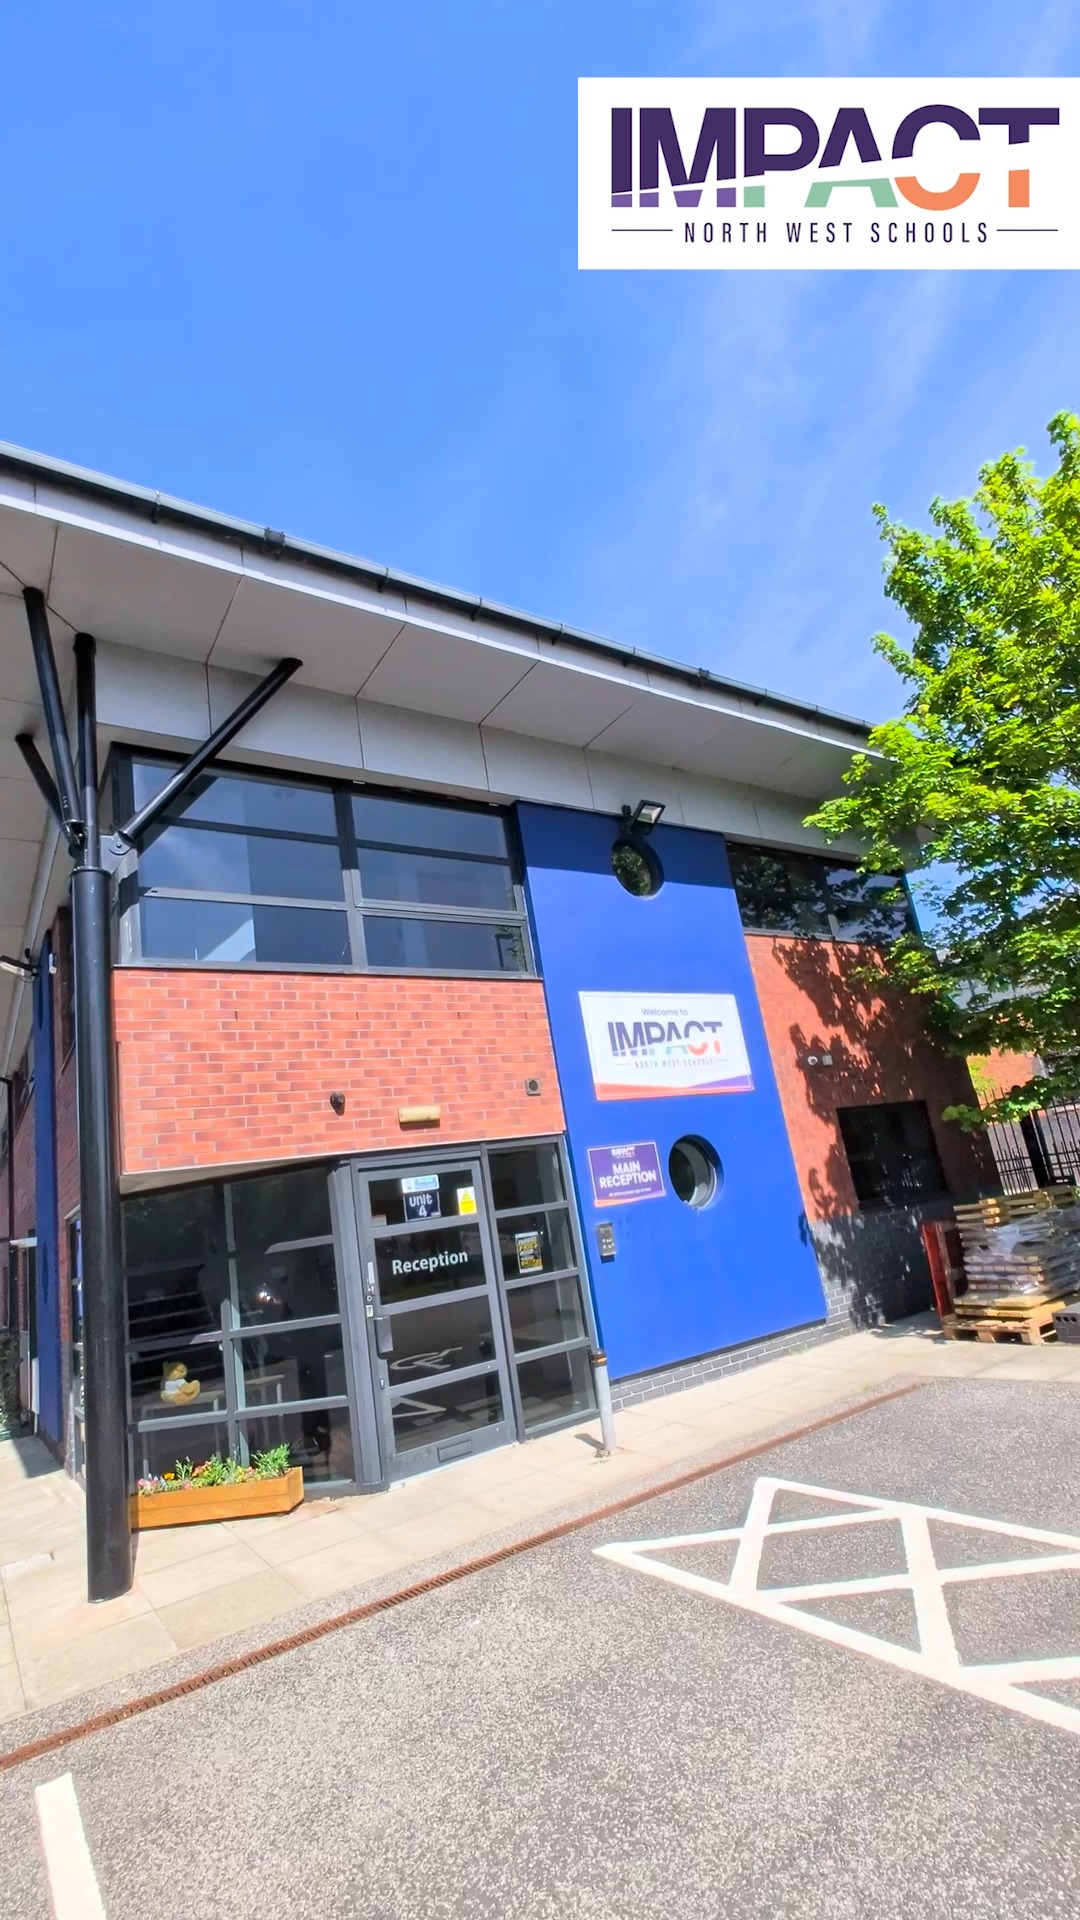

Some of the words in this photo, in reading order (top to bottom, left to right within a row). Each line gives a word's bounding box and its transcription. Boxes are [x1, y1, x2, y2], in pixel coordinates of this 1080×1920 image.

[641, 1008, 678, 1017] Welcome
[680, 1008, 688, 1016] to
[607, 1020, 723, 1057] IMPACT
[612, 1160, 641, 1175] MAIN
[599, 1170, 657, 1189] RECEPTION
[418, 1205, 428, 1217] 4
[391, 1250, 468, 1276] Reception
